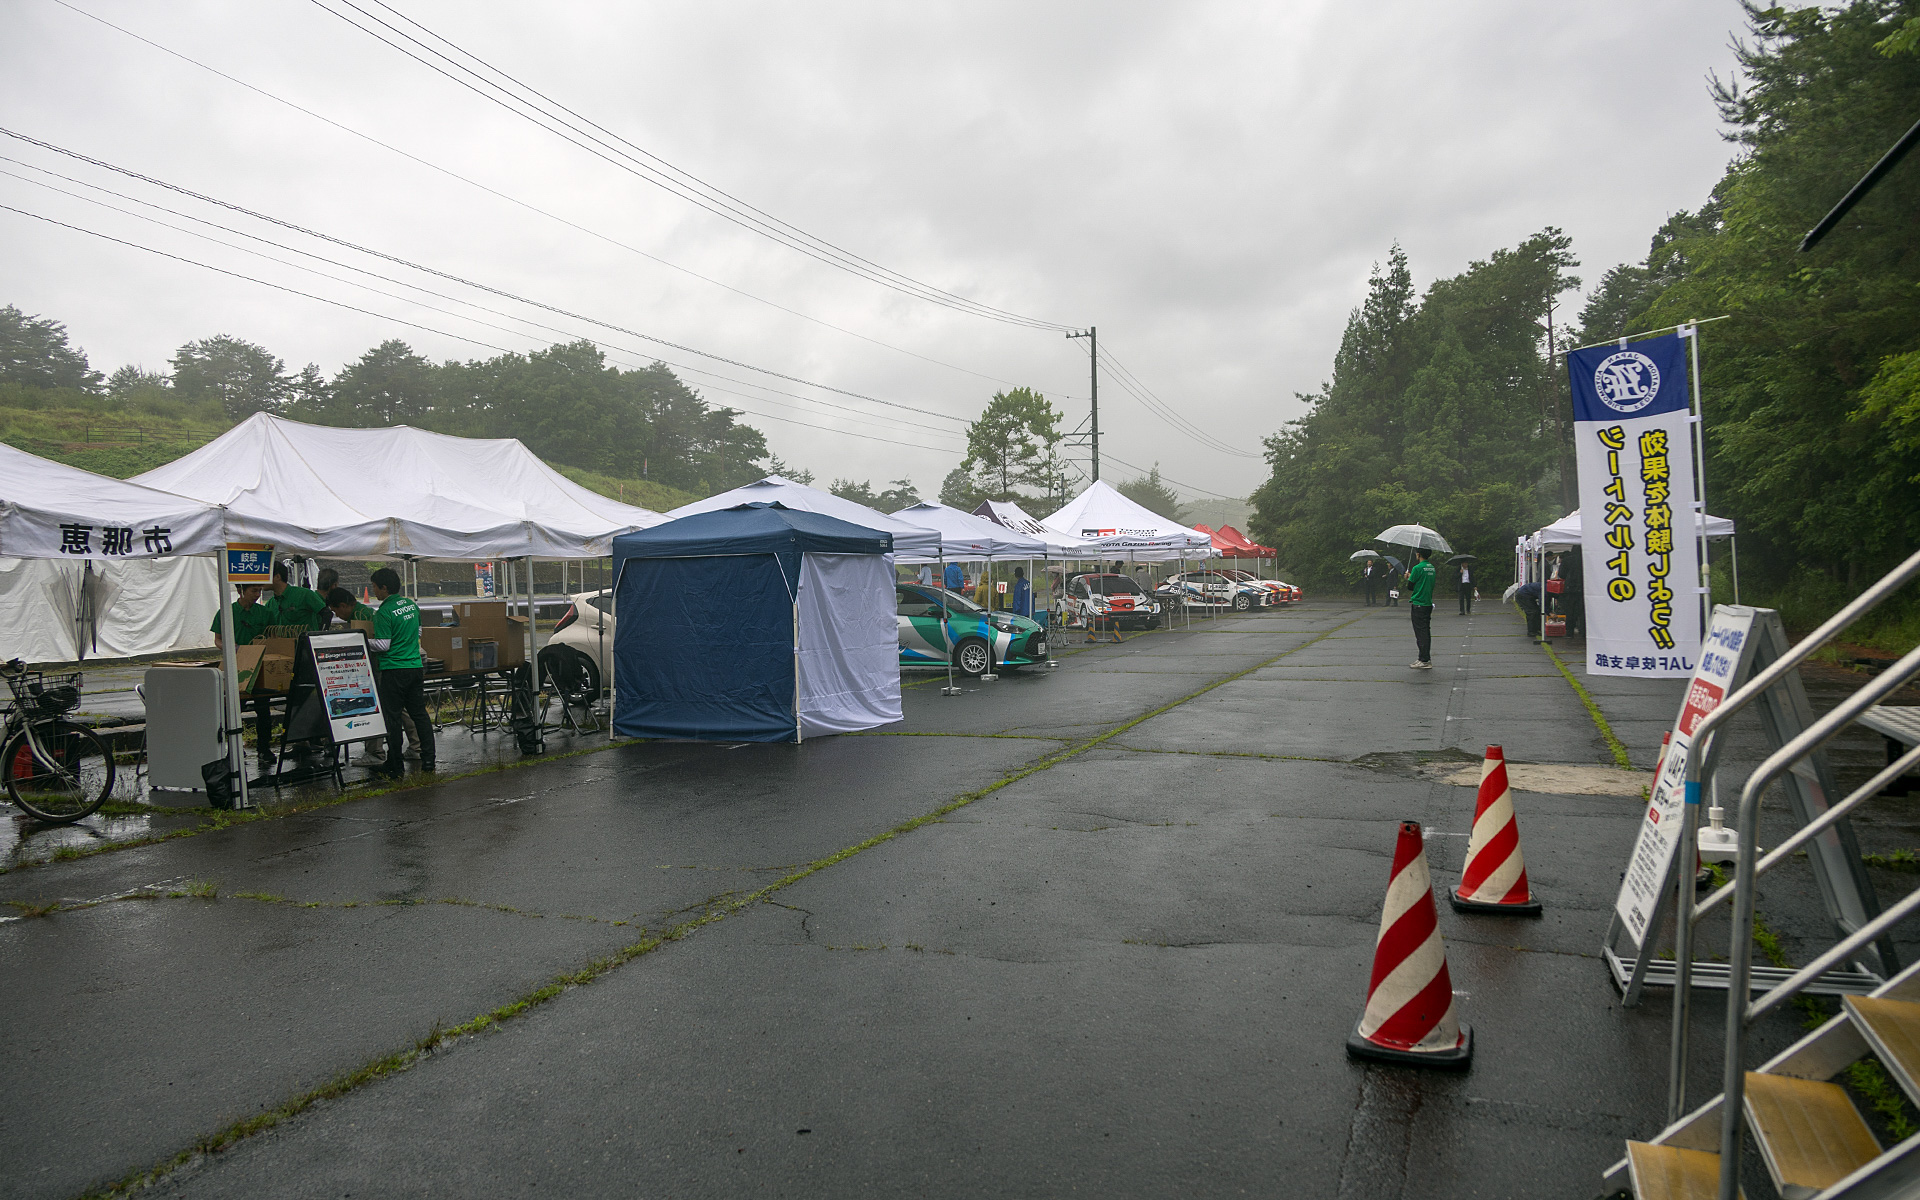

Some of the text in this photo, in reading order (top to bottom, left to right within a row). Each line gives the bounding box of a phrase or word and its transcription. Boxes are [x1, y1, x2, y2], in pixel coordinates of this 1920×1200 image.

[59, 522, 172, 556] 恵那市
[240, 553, 258, 562] 岐阜
[230, 562, 269, 573] トヨペット
